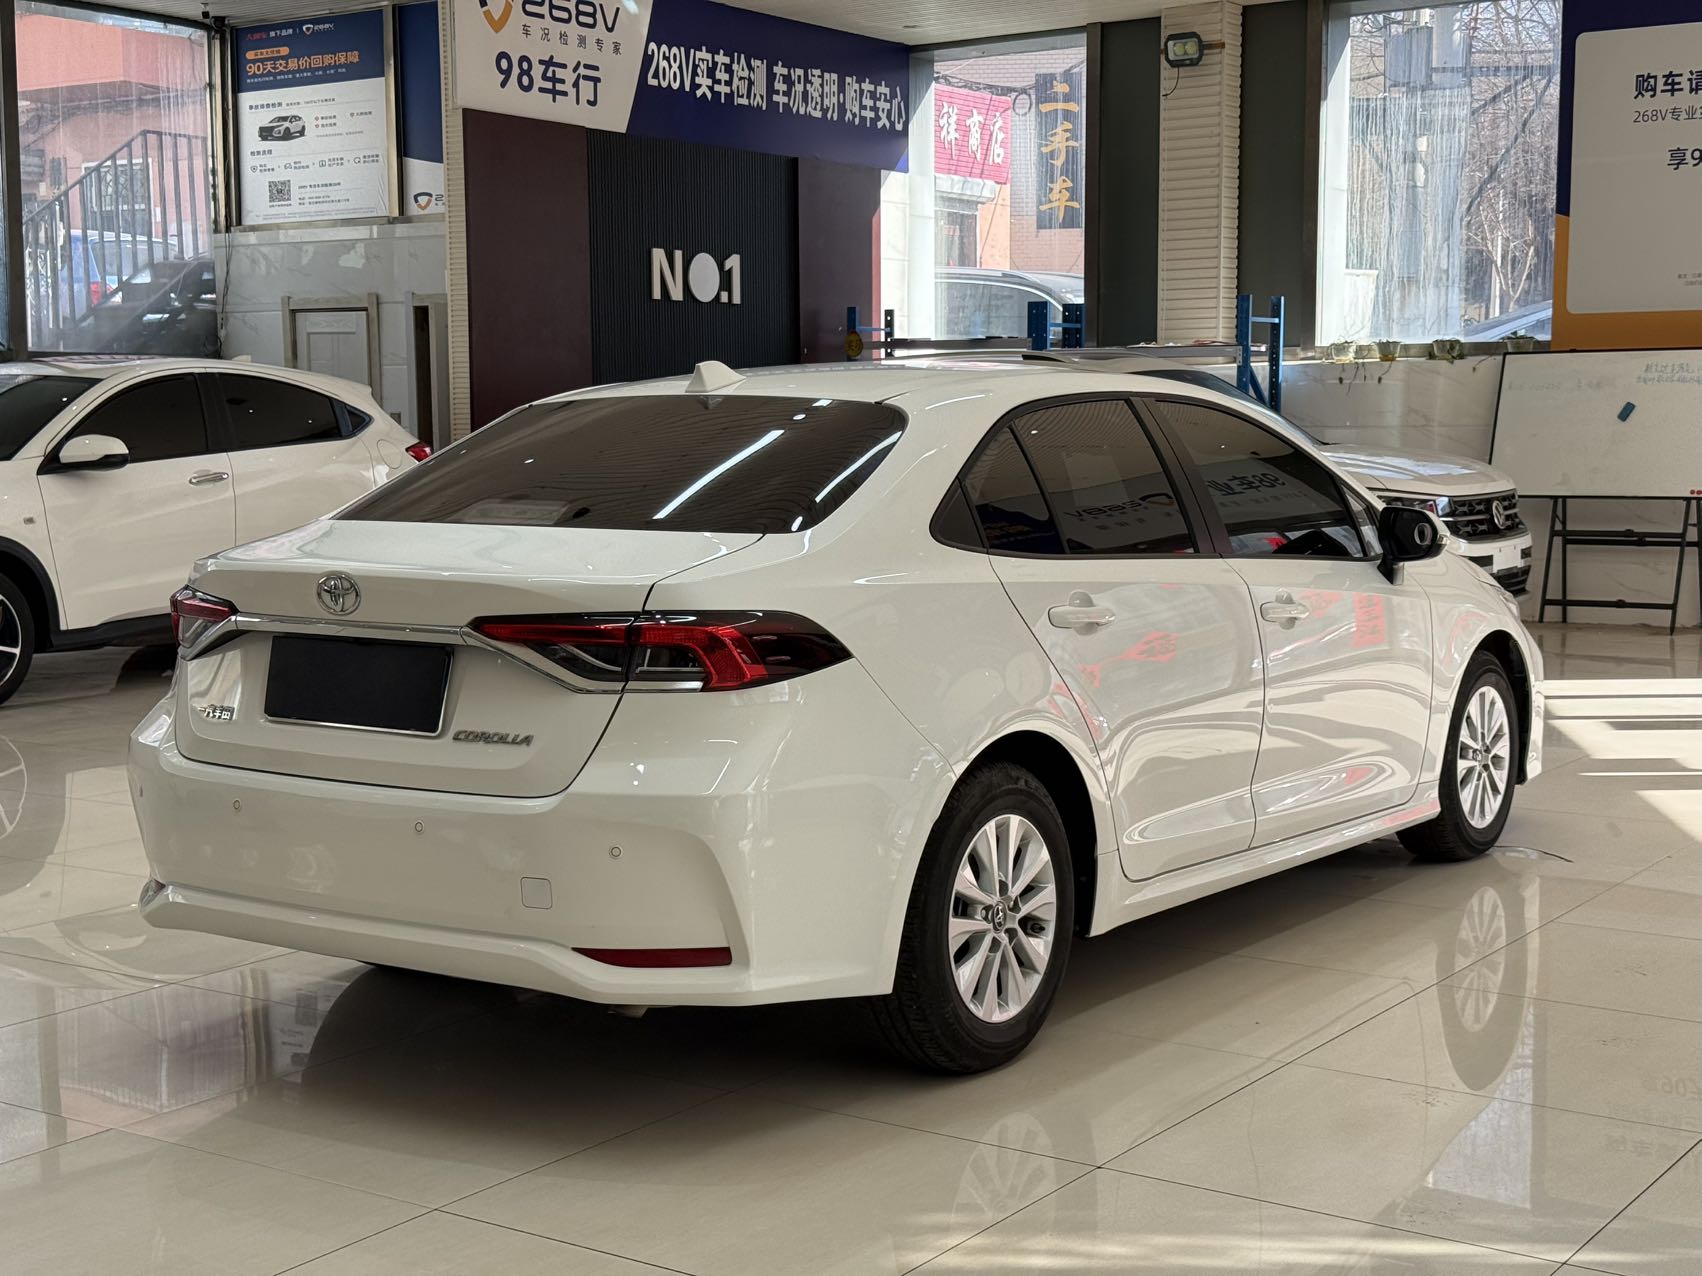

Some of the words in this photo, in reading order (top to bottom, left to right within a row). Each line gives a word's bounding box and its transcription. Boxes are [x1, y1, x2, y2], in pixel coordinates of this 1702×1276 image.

[521, 0, 620, 33] 268V
[521, 24, 622, 56] 车况检测专家
[246, 51, 360, 76] 90天交易价回购保障
[495, 51, 602, 107] 98车行
[647, 41, 767, 111] 268V实车检测
[773, 60, 906, 131] 车况透明·购车安心
[1633, 105, 1702, 123] 268V专业
[1039, 80, 1080, 223] 二手车
[452, 730, 535, 747] COROLLA
